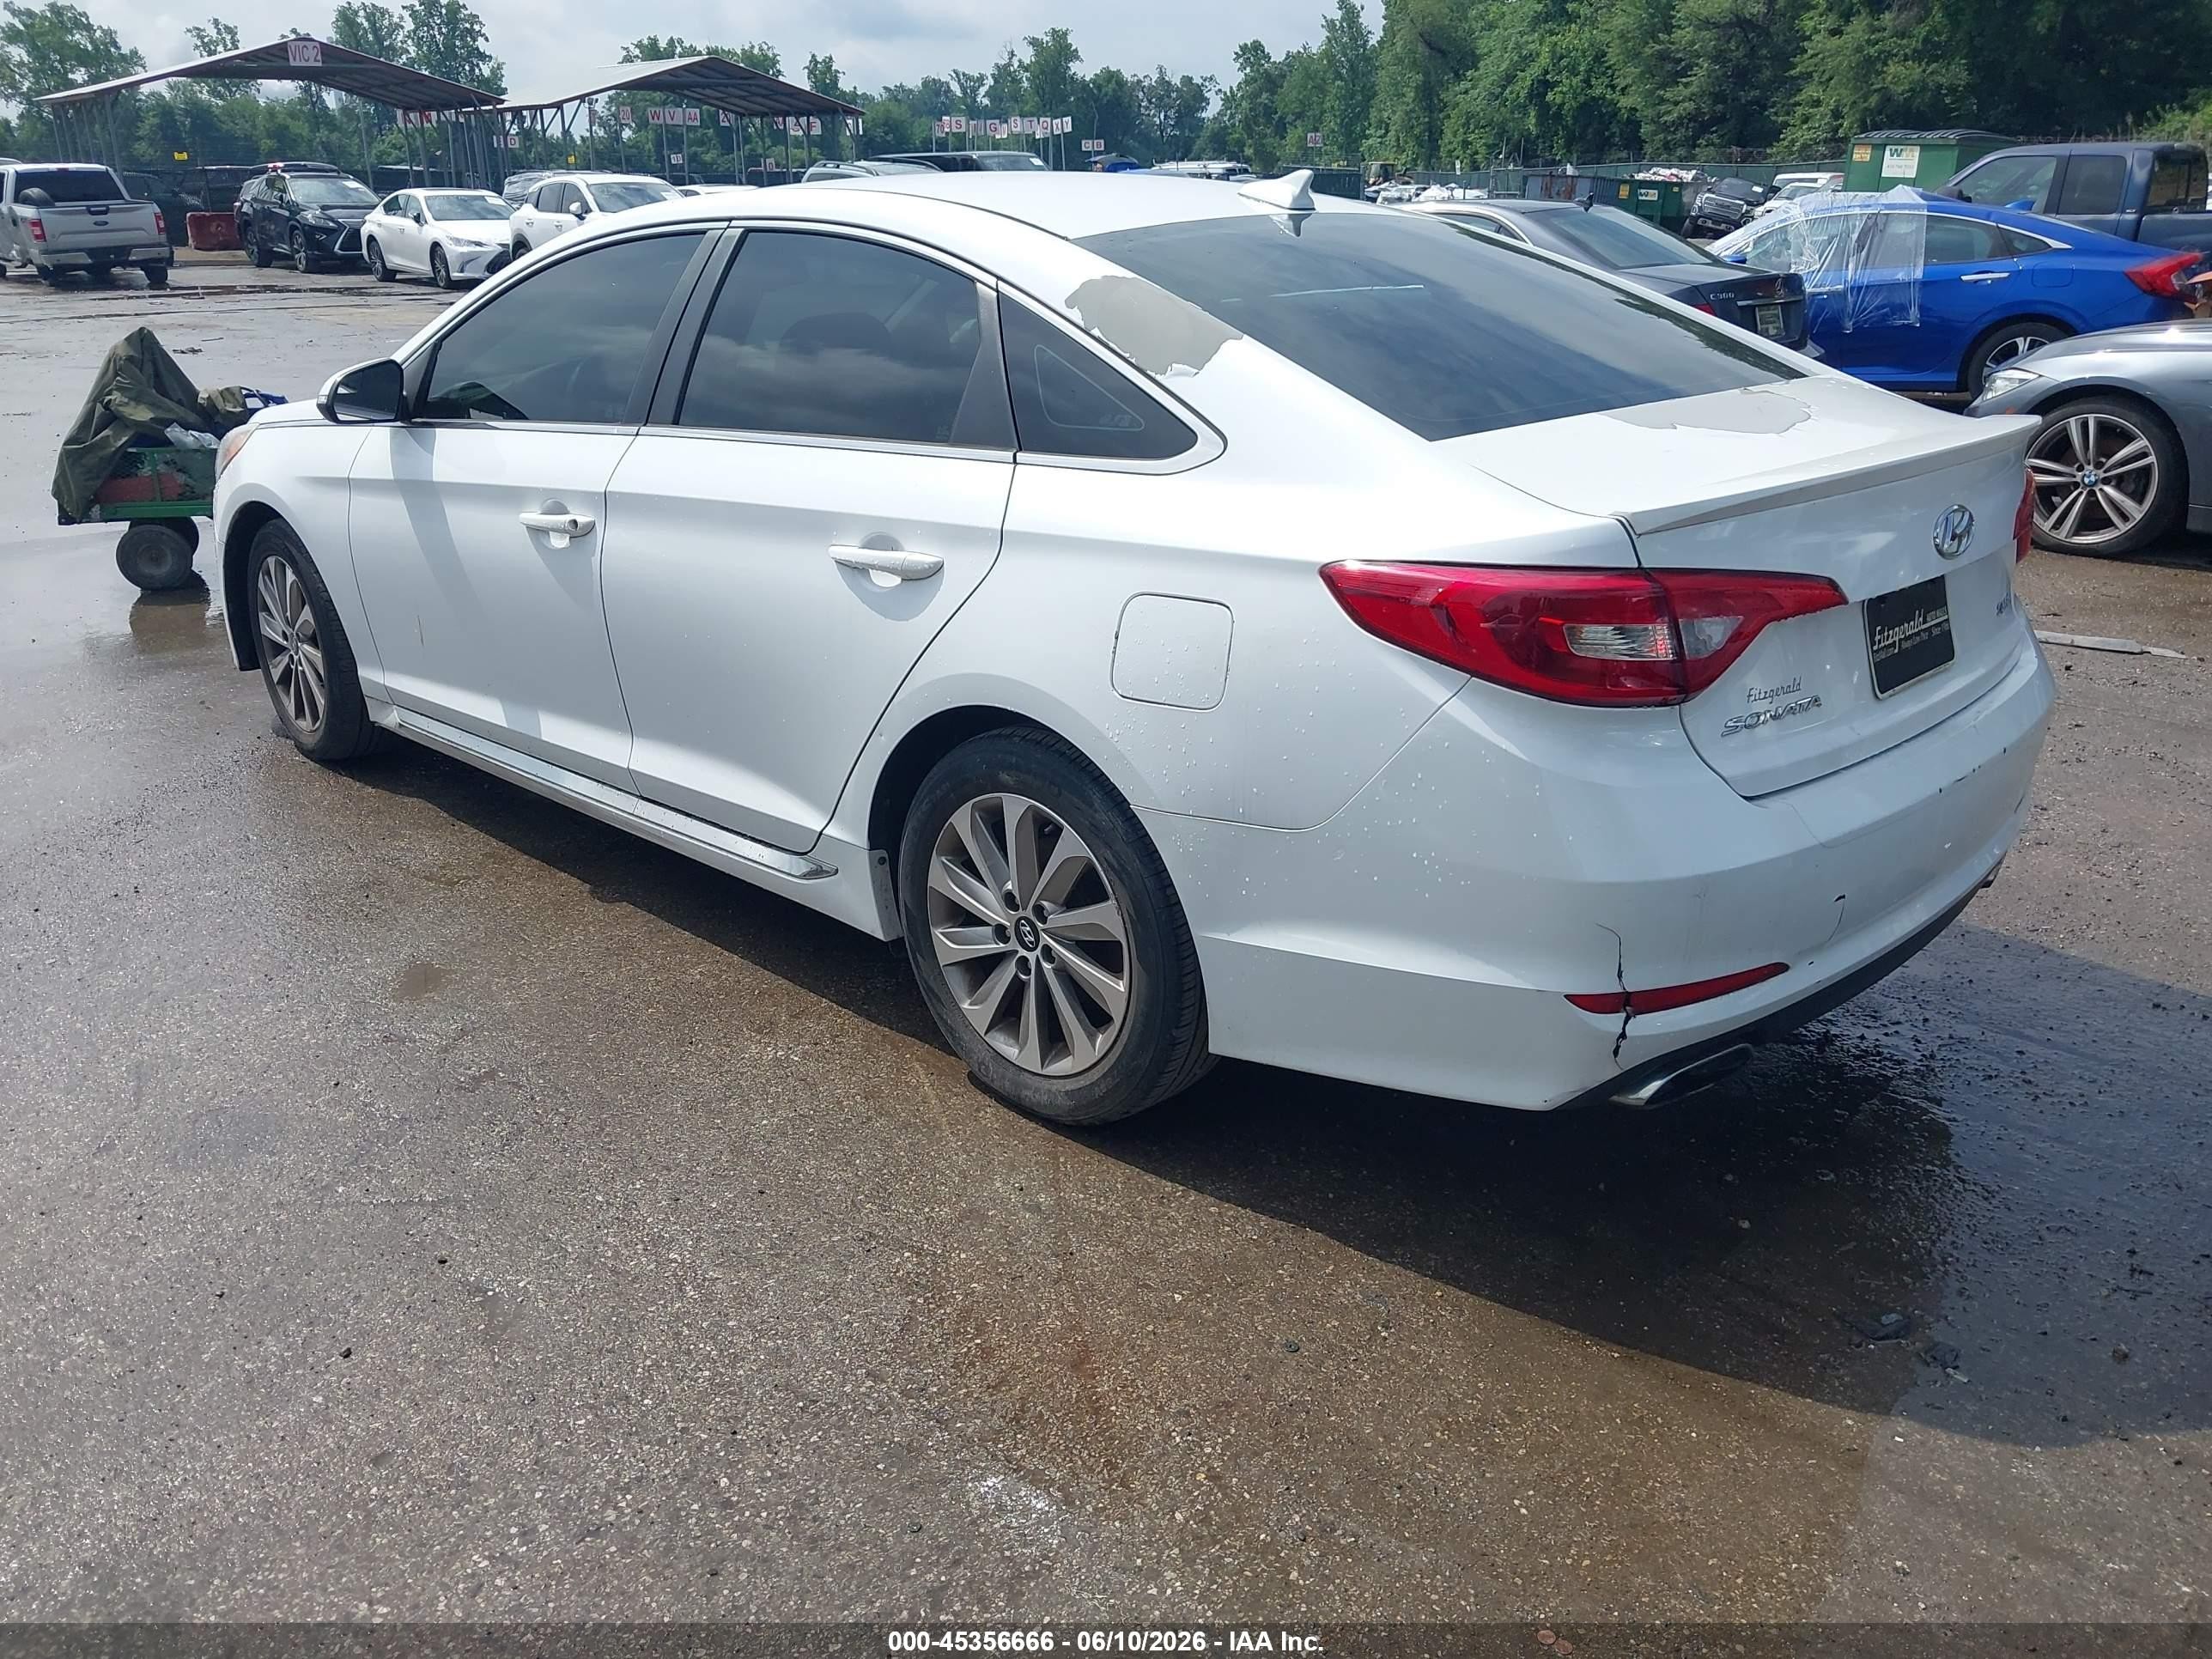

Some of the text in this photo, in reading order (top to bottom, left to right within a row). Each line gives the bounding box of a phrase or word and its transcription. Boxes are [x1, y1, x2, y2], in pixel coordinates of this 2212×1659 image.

[289, 45, 321, 62] VIC 2
[621, 109, 630, 121] 20
[649, 111, 661, 121] W
[667, 111, 676, 121] V
[688, 112, 699, 123] AA
[810, 121, 817, 131] F
[955, 119, 963, 130] S
[988, 122, 998, 132] G
[1013, 118, 1018, 129] S
[1027, 119, 1035, 130] T
[1042, 120, 1049, 131] Q
[1054, 122, 1061, 131] X
[1064, 119, 1070, 129] Y
[509, 137, 516, 146] D
[1084, 141, 1091, 149] C
[1096, 141, 1103, 149] B
[1873, 608, 1924, 653] Fitzgerald
[1747, 677, 1802, 705] Fitzgerald
[1721, 695, 1823, 737] SONATA
